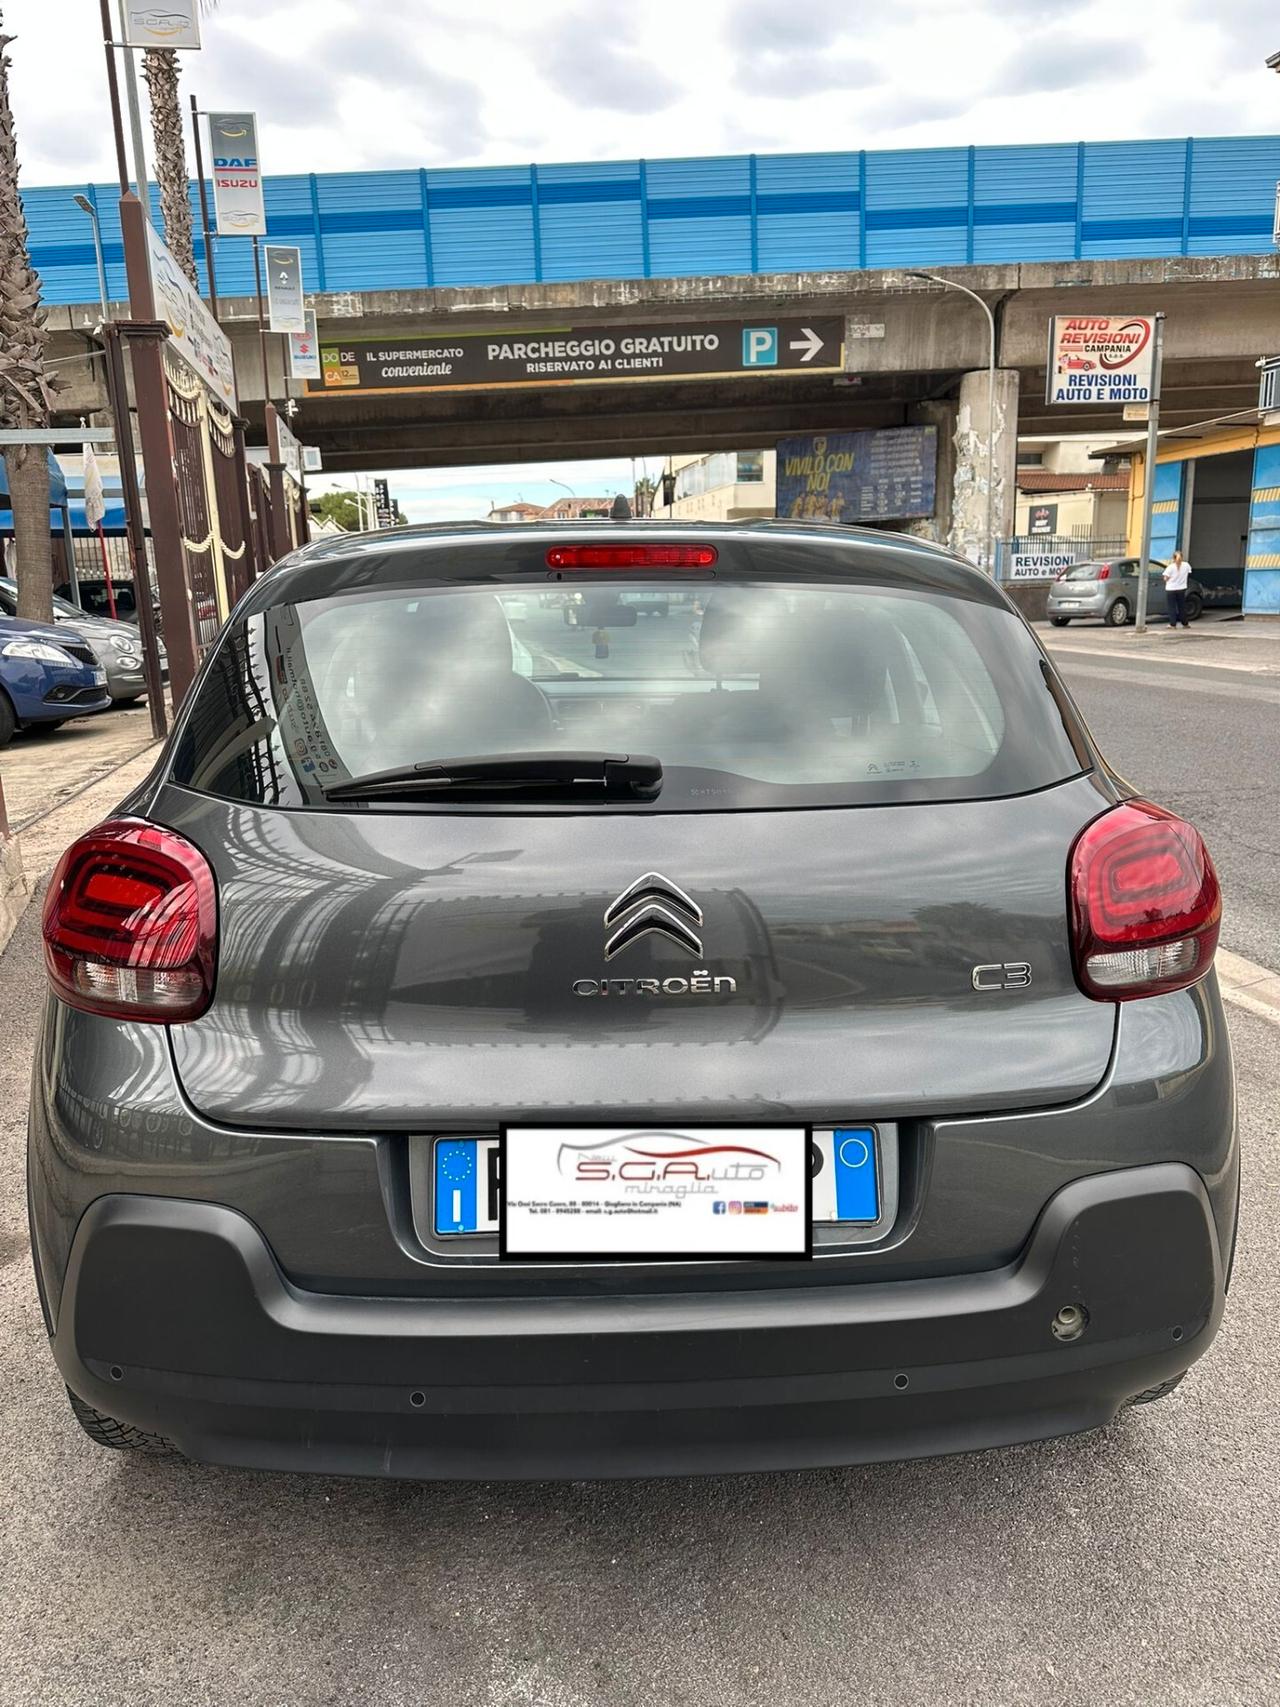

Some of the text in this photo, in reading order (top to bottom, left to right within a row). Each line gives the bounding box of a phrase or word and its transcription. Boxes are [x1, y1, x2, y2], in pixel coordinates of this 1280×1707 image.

[214, 158, 257, 167] DAF
[217, 179, 258, 188] ISUZU
[1065, 320, 1110, 330] AUTO
[1060, 333, 1141, 344] REVISIONI
[488, 334, 720, 361] PARCHEGGIO GRATUITO
[750, 332, 772, 363] P
[322, 352, 356, 362] DO DE
[367, 348, 464, 361] IL SUPERMERCATO
[381, 361, 453, 378] conveniente
[527, 357, 663, 373] RISERVATO AI CLIENTI
[1069, 374, 1137, 387] REVISIONI
[1056, 388, 1148, 401] AUTO E MOTO
[785, 452, 855, 476] VIVILO CON
[1015, 556, 1074, 567] REVISIONI
[1014, 568, 1039, 577] AUTO
[972, 962, 1032, 990] C3
[572, 970, 737, 996] CITROËN
